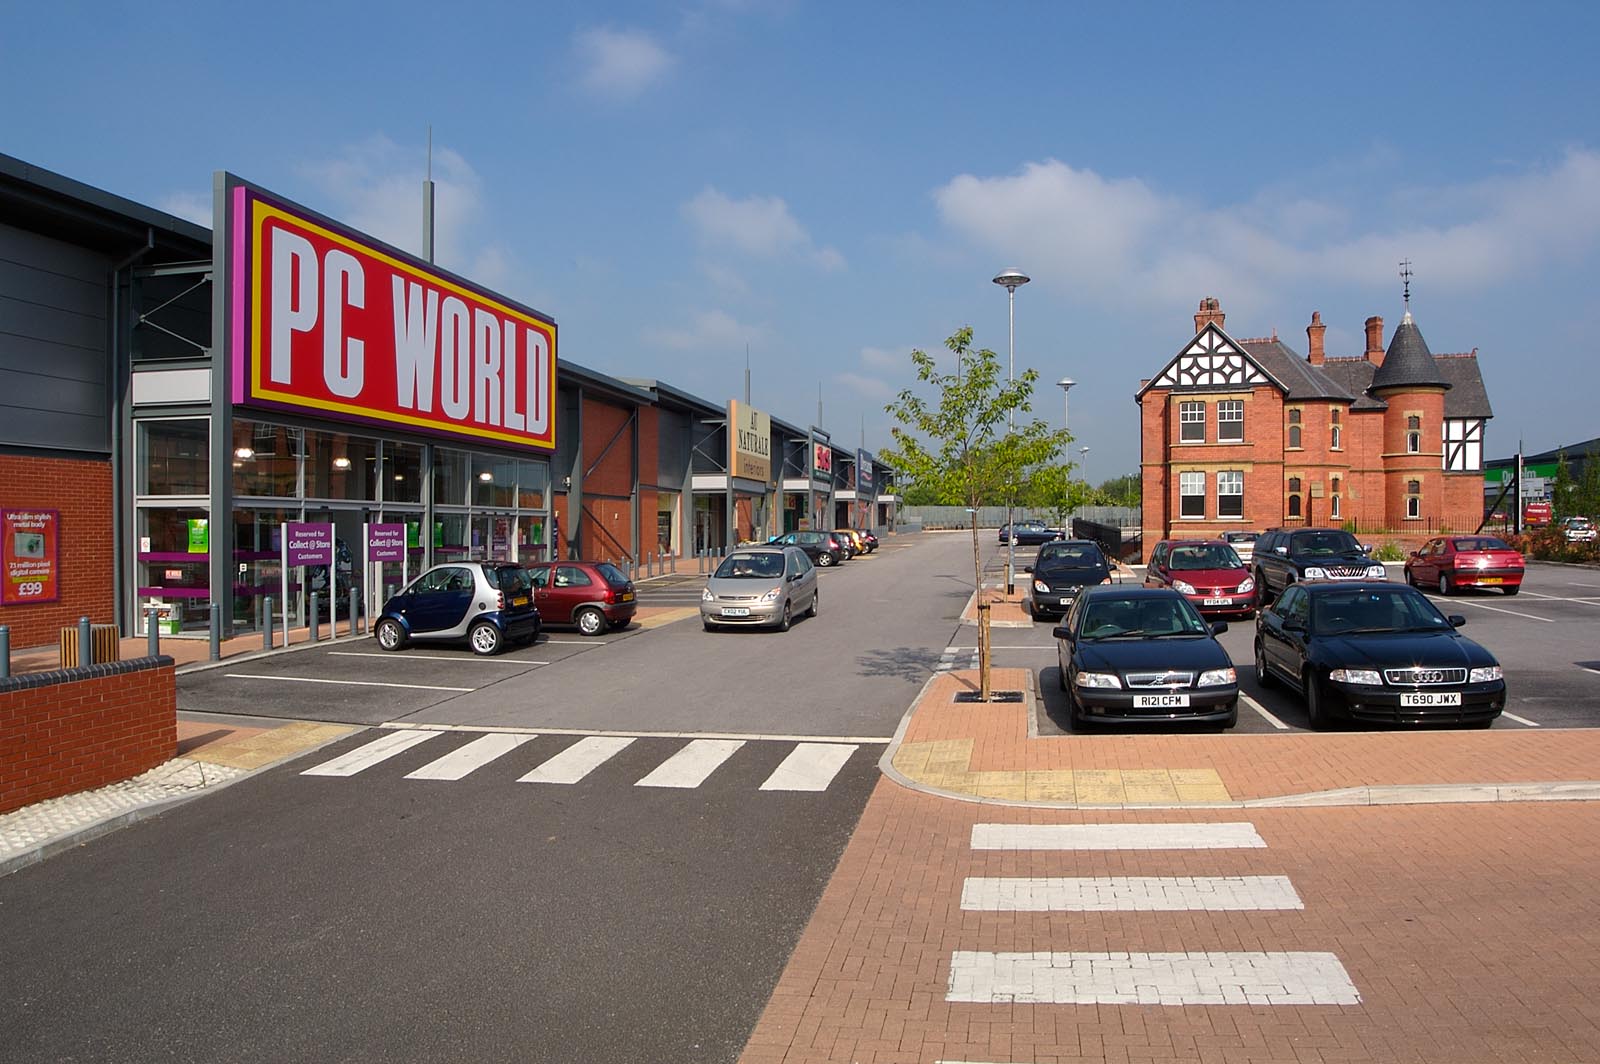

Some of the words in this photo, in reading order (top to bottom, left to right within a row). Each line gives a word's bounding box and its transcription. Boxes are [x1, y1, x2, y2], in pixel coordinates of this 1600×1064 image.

[270, 225, 365, 398] PC
[391, 273, 549, 435] WORLD
[738, 428, 769, 456] NATURALE
[289, 540, 309, 549] Collect
[309, 540, 315, 549] @
[316, 541, 331, 549] Store
[369, 539, 386, 547] Collect
[391, 538, 403, 546] Store
[18, 582, 43, 596] £99
[1141, 696, 1160, 706] R121
[1162, 695, 1182, 706] CFM
[1405, 695, 1433, 705] T690
[1436, 694, 1457, 704] JWX
